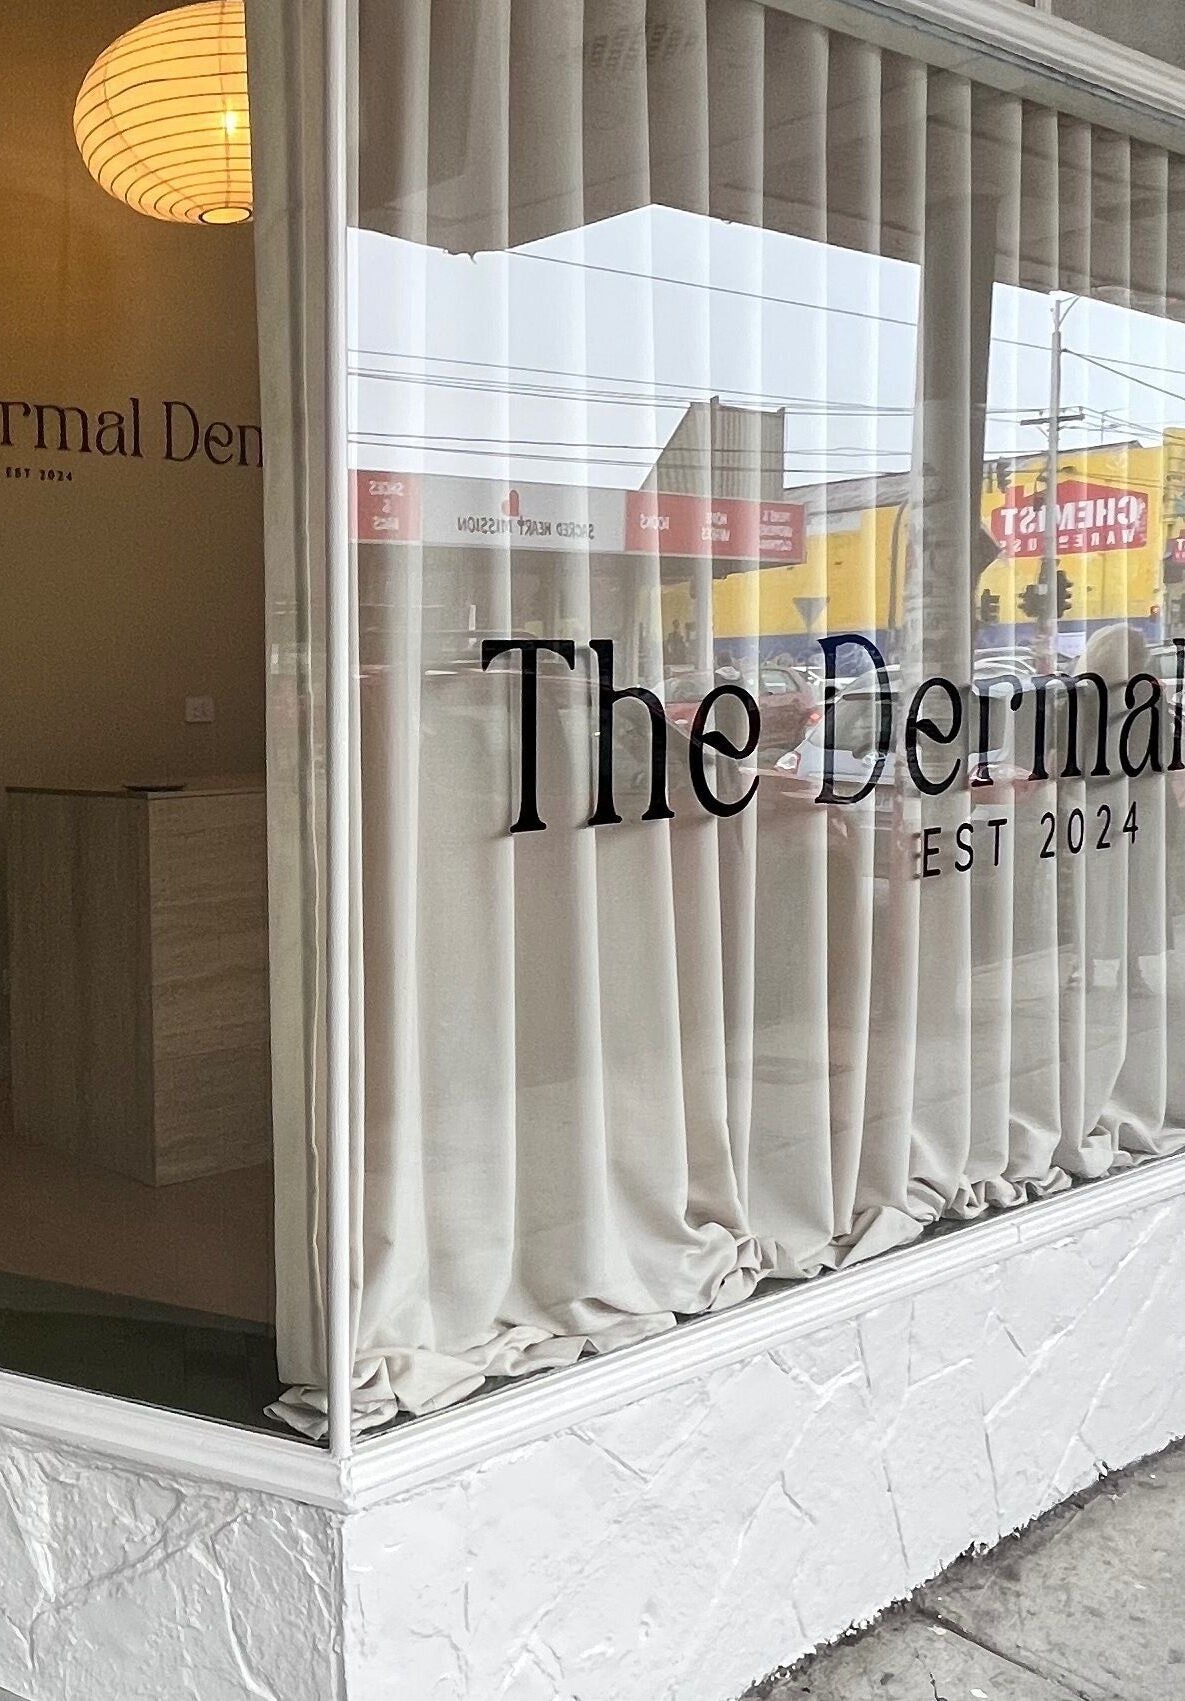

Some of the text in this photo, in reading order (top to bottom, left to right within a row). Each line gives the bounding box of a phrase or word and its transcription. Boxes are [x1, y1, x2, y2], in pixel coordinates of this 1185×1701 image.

[5, 466, 72, 481] EST 2024
[481, 633, 1185, 834] The Dermal
[922, 801, 1139, 877] EST 2024
